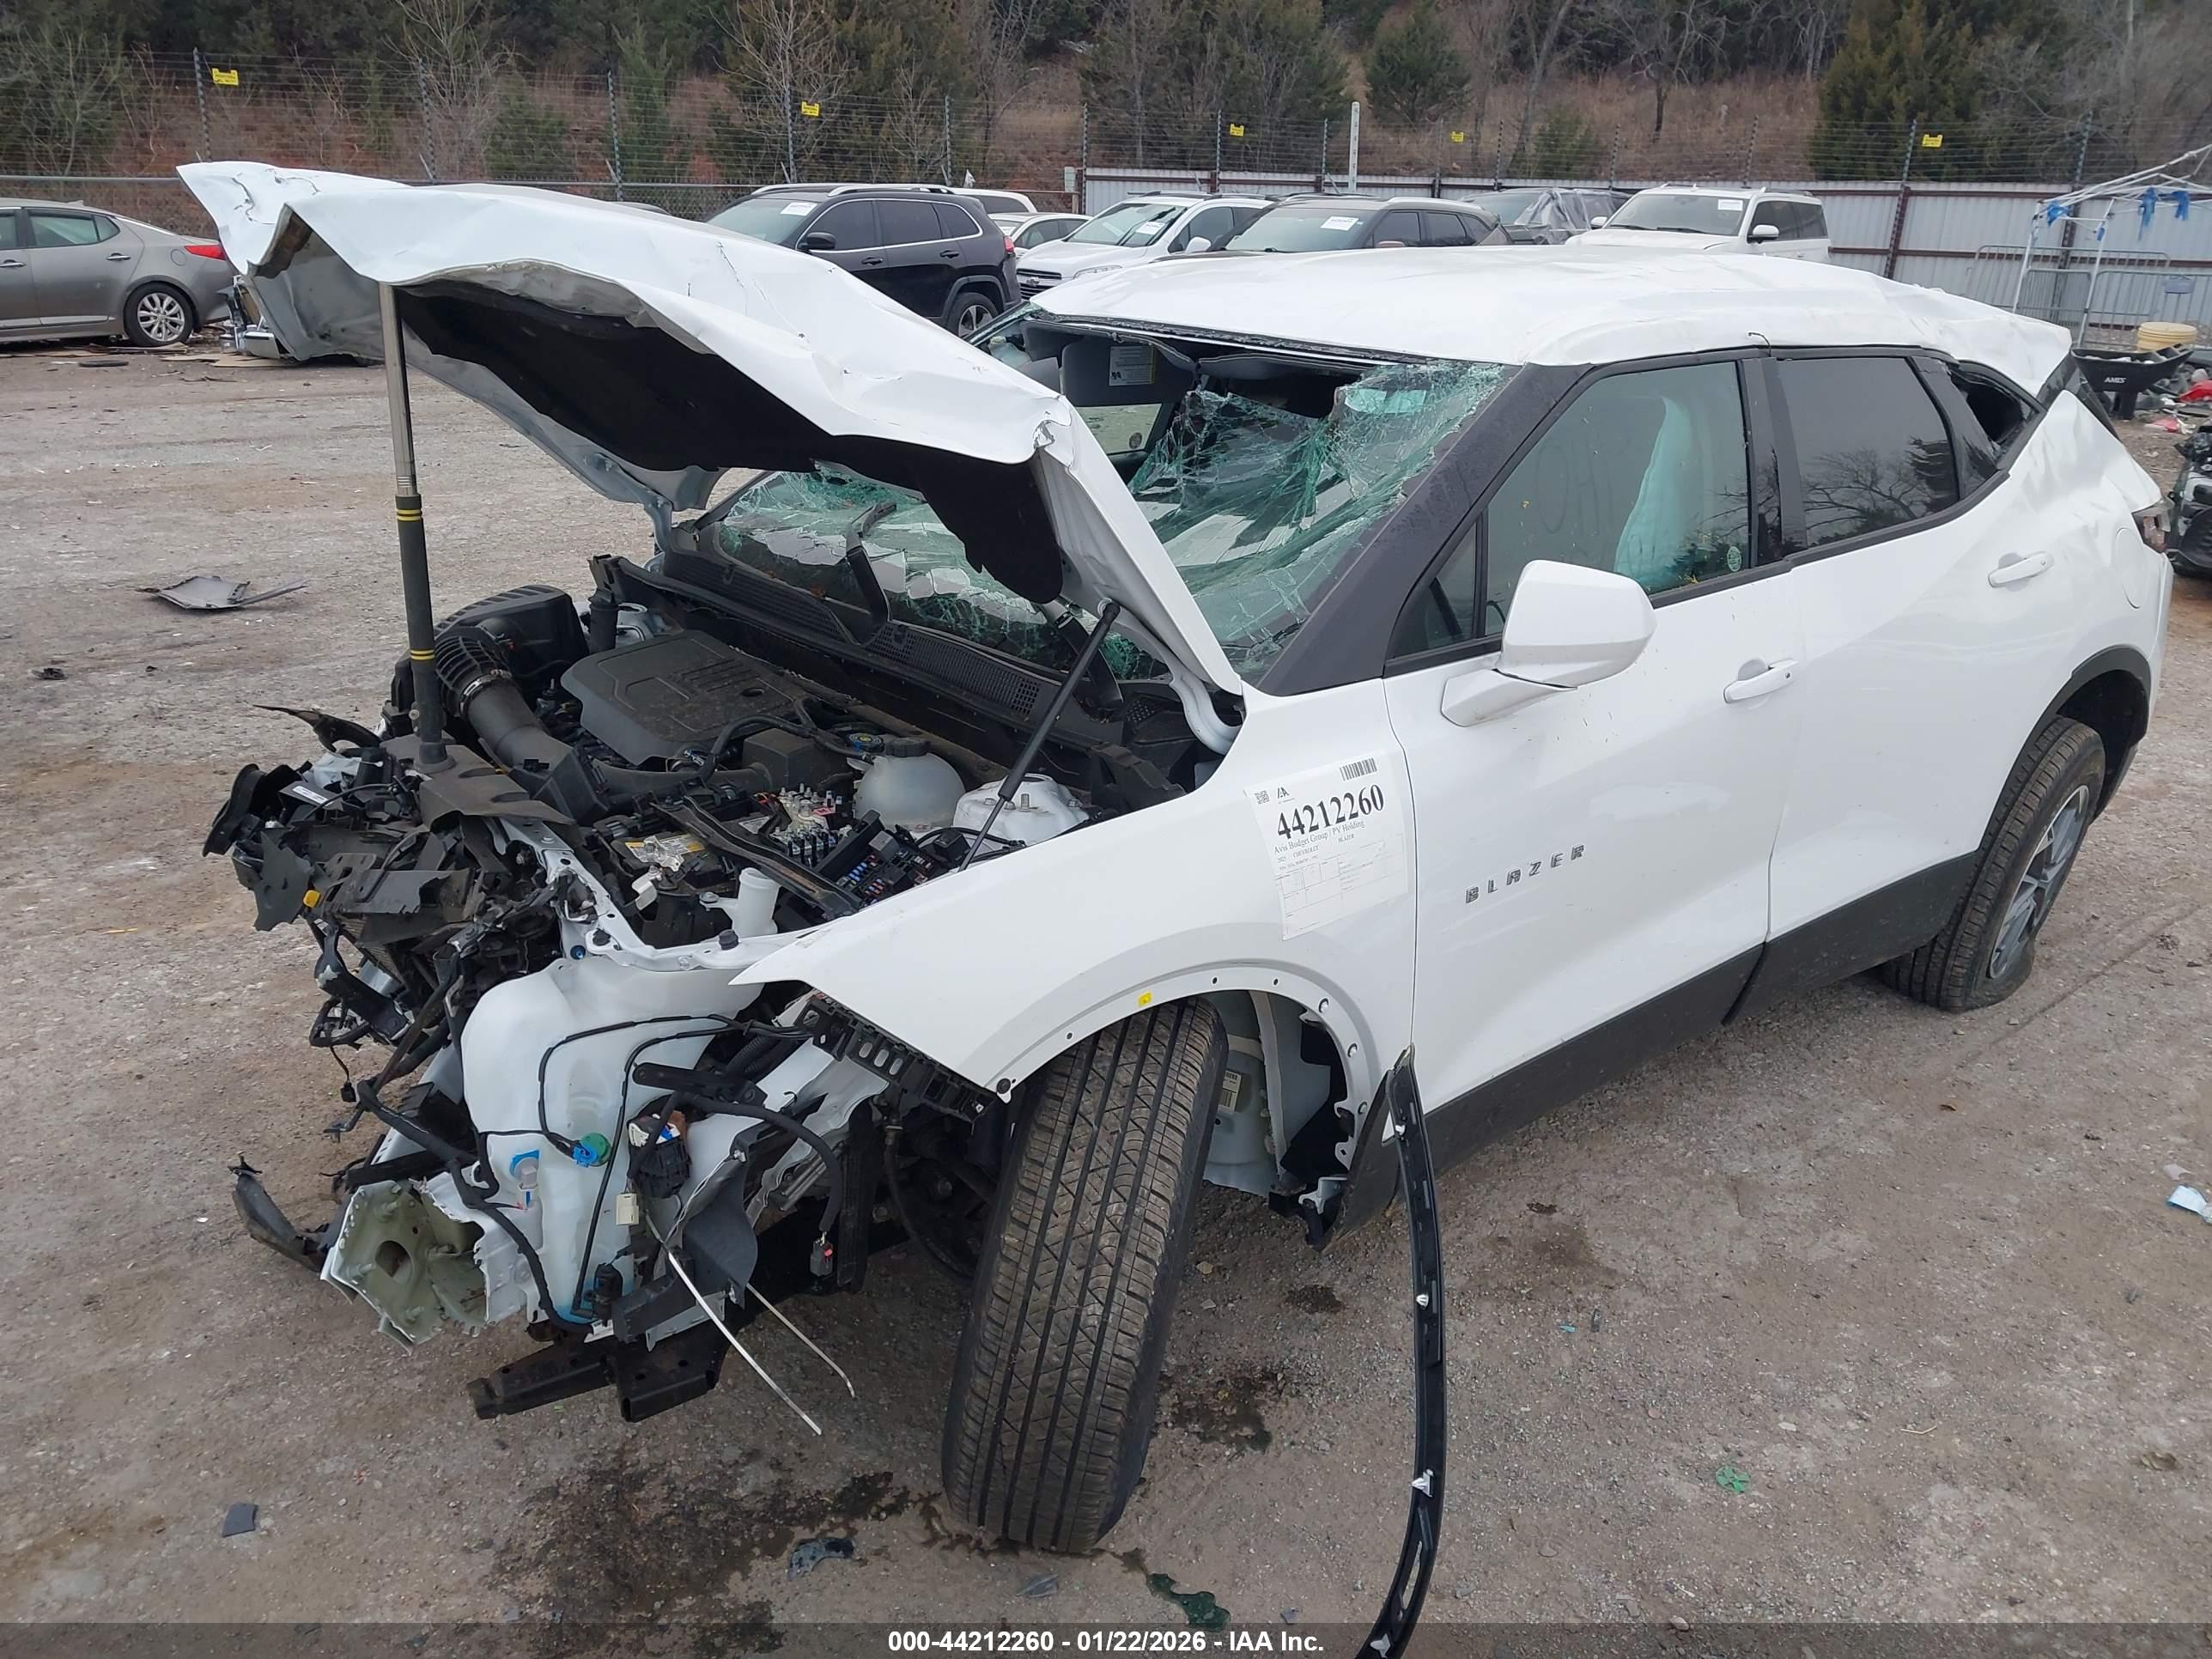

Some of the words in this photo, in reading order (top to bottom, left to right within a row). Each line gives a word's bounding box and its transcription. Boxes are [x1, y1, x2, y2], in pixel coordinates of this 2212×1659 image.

[1277, 784, 1384, 840] 44212260
[1274, 844, 1288, 854] Avis
[1288, 837, 1309, 850] Budget
[1310, 831, 1328, 842] Group
[1341, 821, 1365, 833] Holding
[1292, 845, 1319, 858] CHEVROLET
[1465, 844, 1585, 904] BLAZER
